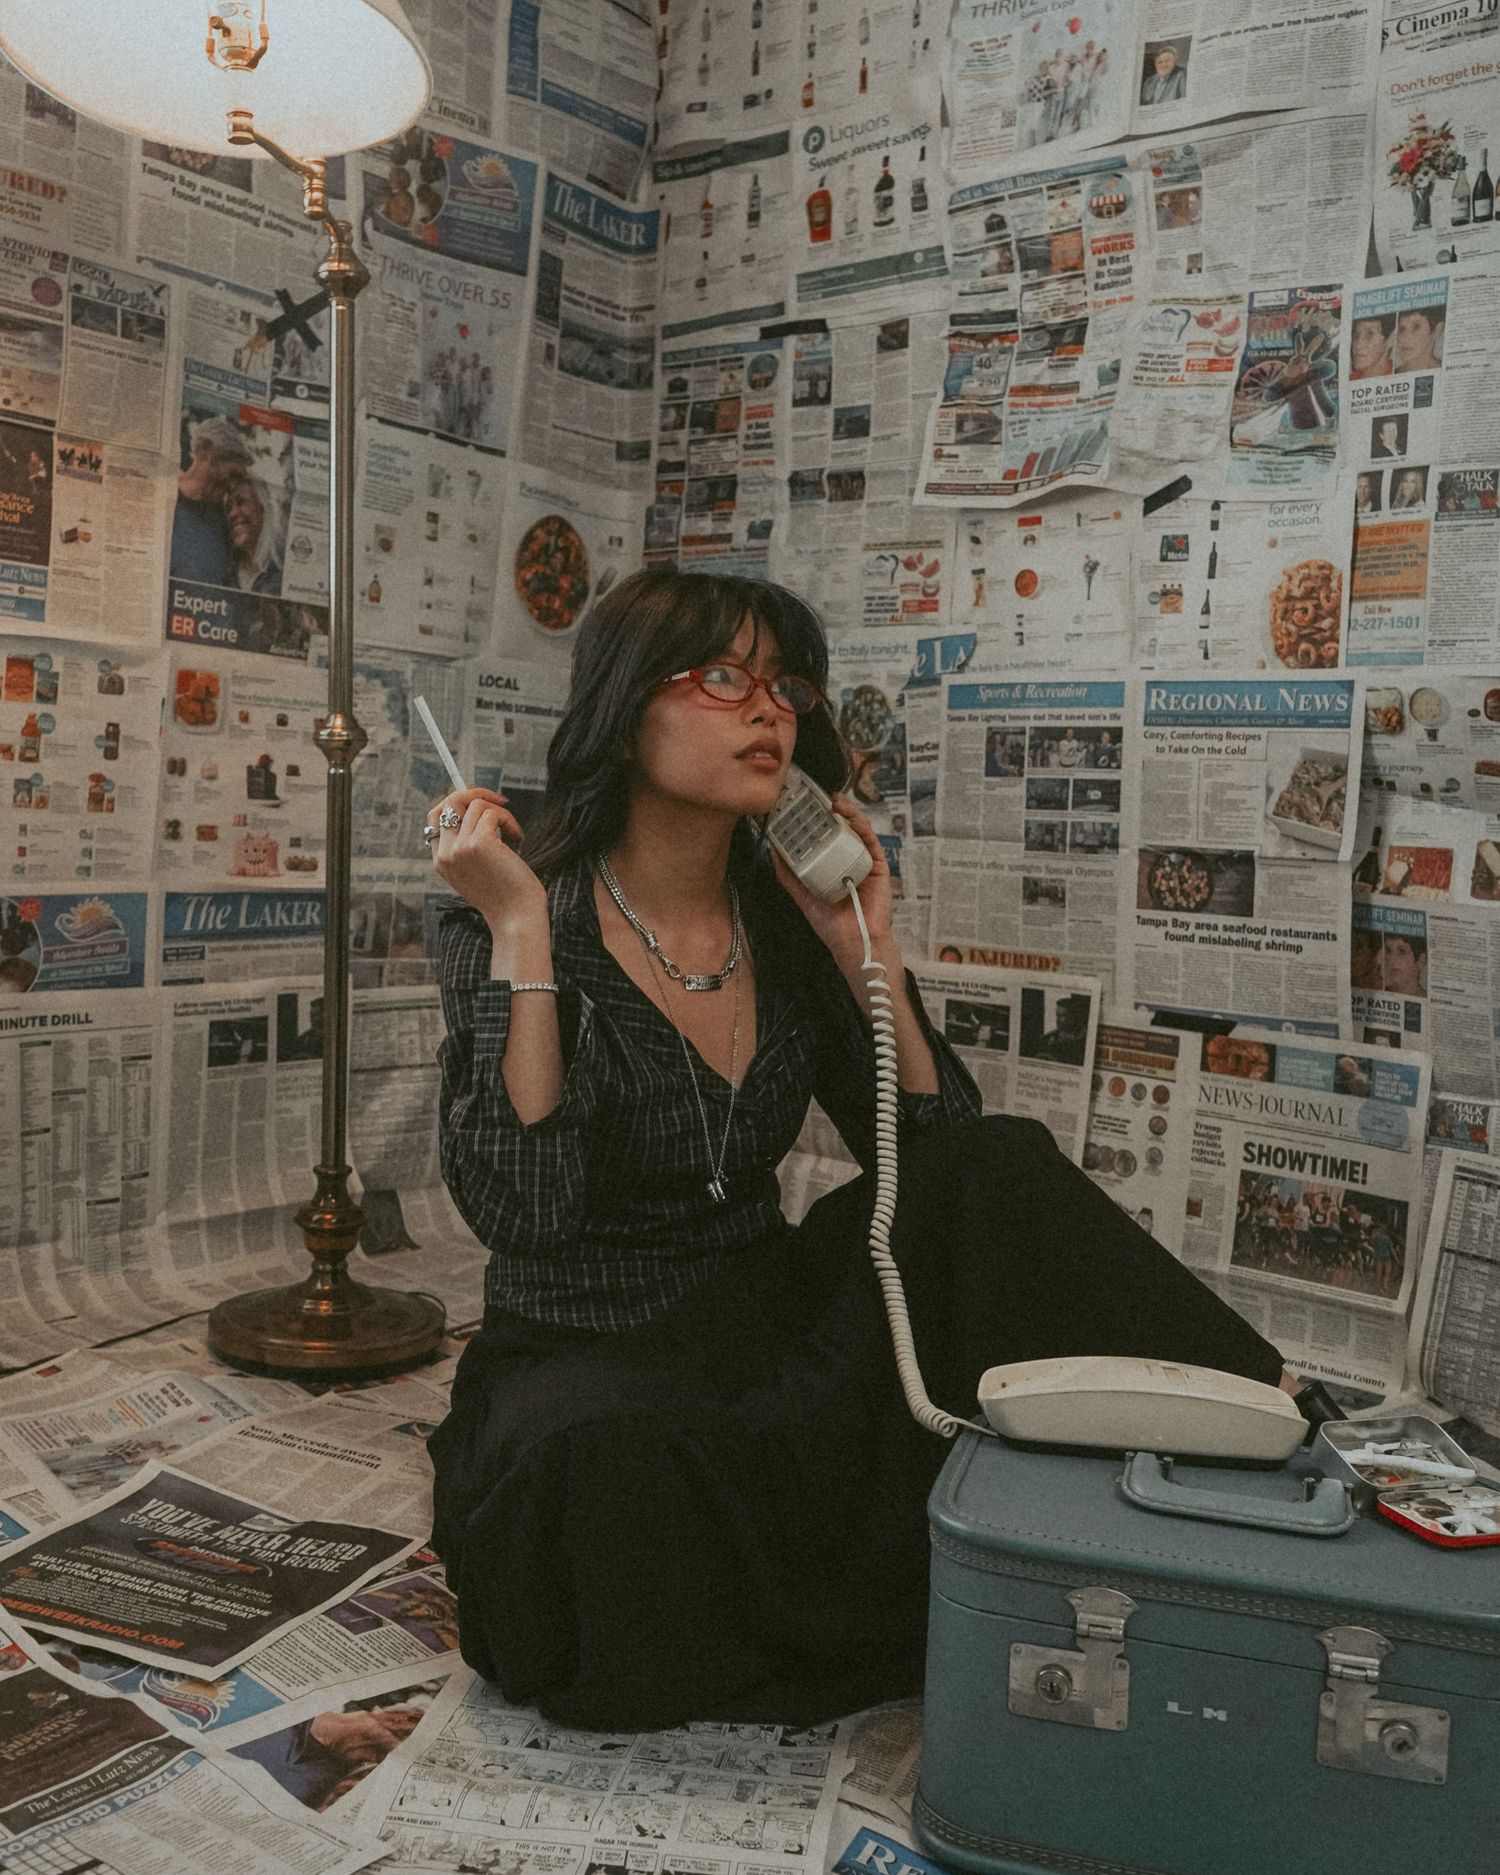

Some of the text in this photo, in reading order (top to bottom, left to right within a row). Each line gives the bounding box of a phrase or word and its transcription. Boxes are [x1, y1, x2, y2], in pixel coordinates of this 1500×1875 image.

[1304, 14, 1335, 24] frustrated
[1337, 8, 1368, 19] neighbors
[1396, 6, 1469, 36] Cinema
[1390, 78, 1425, 96] Don't
[1428, 69, 1468, 85] forget
[1472, 62, 1493, 76] the
[830, 114, 890, 143] Liquors
[808, 121, 931, 172] Sweet sweet savings
[142, 162, 319, 235] Tampa Bay area seafood restaurants
[554, 181, 584, 224] The
[172, 186, 295, 239] found mislabeling shrimp
[1091, 239, 1135, 257] WORKS
[1110, 254, 1130, 265] Best
[1107, 264, 1133, 277] Small
[380, 253, 512, 310] THRIVE OVER 55
[1094, 277, 1133, 292] Business
[1404, 280, 1447, 297] SEMINAR
[1351, 382, 1410, 400] TOP RATED
[1351, 394, 1409, 408] BOARD CERTIFIED
[1453, 472, 1492, 483] CHALK
[1466, 481, 1495, 492] TALK
[1270, 502, 1323, 516] for every
[1268, 514, 1323, 528] occasion.
[173, 588, 227, 617] Expert
[1364, 605, 1393, 615] Call Now
[172, 615, 238, 643] ER Care
[1350, 615, 1421, 631] 2-227-1501
[479, 674, 520, 691] LOCAL
[977, 683, 1088, 703] Sports & Recreation
[1150, 688, 1349, 713] REGIONAL NEWS
[1109, 712, 1122, 721] life
[1144, 730, 1262, 743] Cozy, Comforting Recipes
[909, 742, 940, 755] BayCar
[1156, 745, 1248, 756] to Take On the Cold
[1074, 866, 1115, 878] Olympics
[182, 894, 322, 932] The LAKER
[1387, 910, 1424, 925] SEMINAR
[1136, 914, 1338, 942] Tampa Bay area seafood restaurants
[1164, 930, 1304, 955] found mislabeling shrimp
[1368, 998, 1401, 1012] RATED
[51, 1012, 93, 1028] DRILL
[1196, 1122, 1222, 1133] Trump
[1458, 1113, 1485, 1126] TALK
[1192, 1139, 1222, 1149] revisits
[1194, 1130, 1221, 1141] budget
[1192, 1147, 1224, 1159] rejected
[1190, 1156, 1226, 1168] cutbacks
[1242, 1140, 1369, 1186] SHOWTIME!
[1284, 1358, 1387, 1389] nroll in Volusia County
[237, 1429, 297, 1449] Hamilton
[298, 1444, 381, 1470] commitment
[279, 1431, 340, 1452] Mercedes
[340, 1447, 382, 1463] awaits
[136, 1498, 368, 1562] YOU'VE NEVER HEARD
[248, 1548, 286, 1564] THIS
[30, 1561, 258, 1620] AT DAYTONA INTERNATIONAL SPEEDWAY
[32, 1554, 273, 1617] DAILY LIVE COVERAGE FROM THE FANZONE
[1167, 1702, 1228, 1723] L M
[24, 1797, 52, 1815] The
[50, 1782, 91, 1804] LAKER
[122, 1745, 160, 1769] NEWS
[114, 1758, 192, 1809] PUZZLE
[385, 1815, 442, 1827] FRANK AND ERNEST
[516, 1842, 531, 1850] THIS
